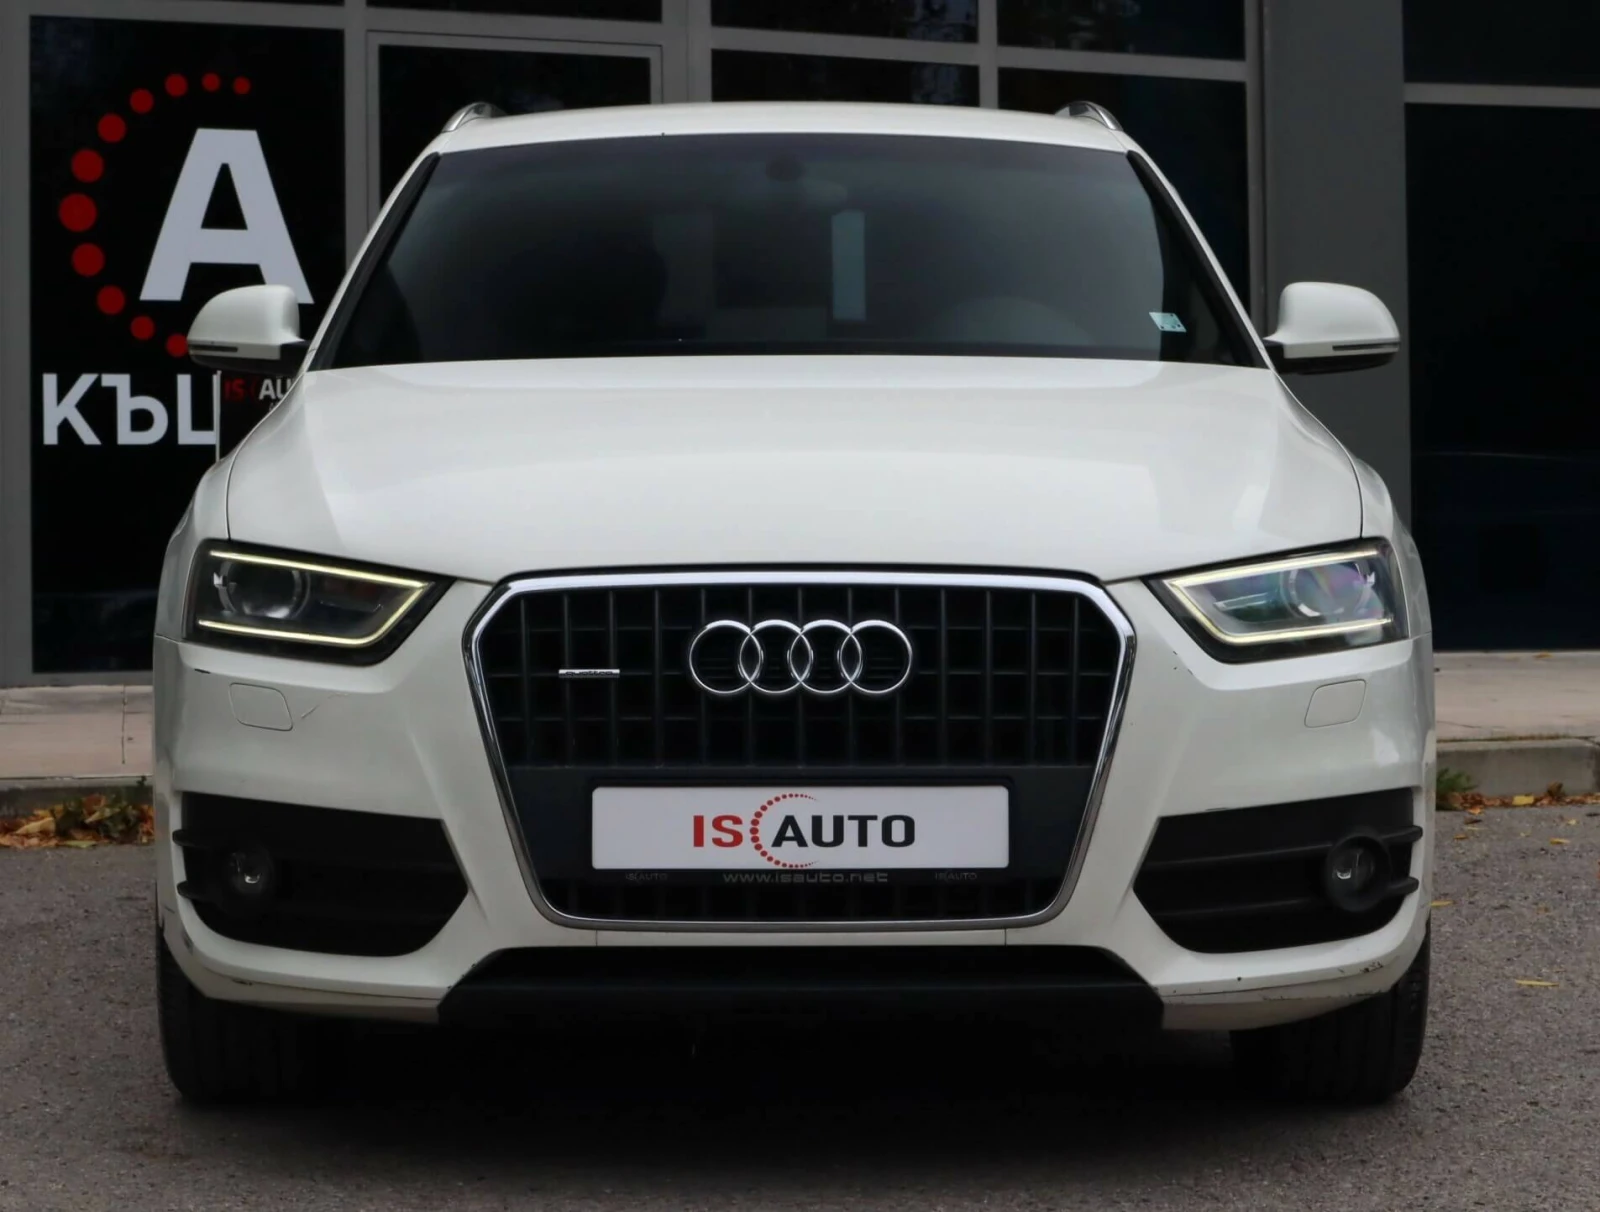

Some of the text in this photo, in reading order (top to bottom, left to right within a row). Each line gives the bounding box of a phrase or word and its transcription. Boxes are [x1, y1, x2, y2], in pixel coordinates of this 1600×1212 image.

[258, 377, 293, 400] AU
[693, 815, 915, 847] IS AUTO
[722, 871, 889, 884] www.isauto.net
